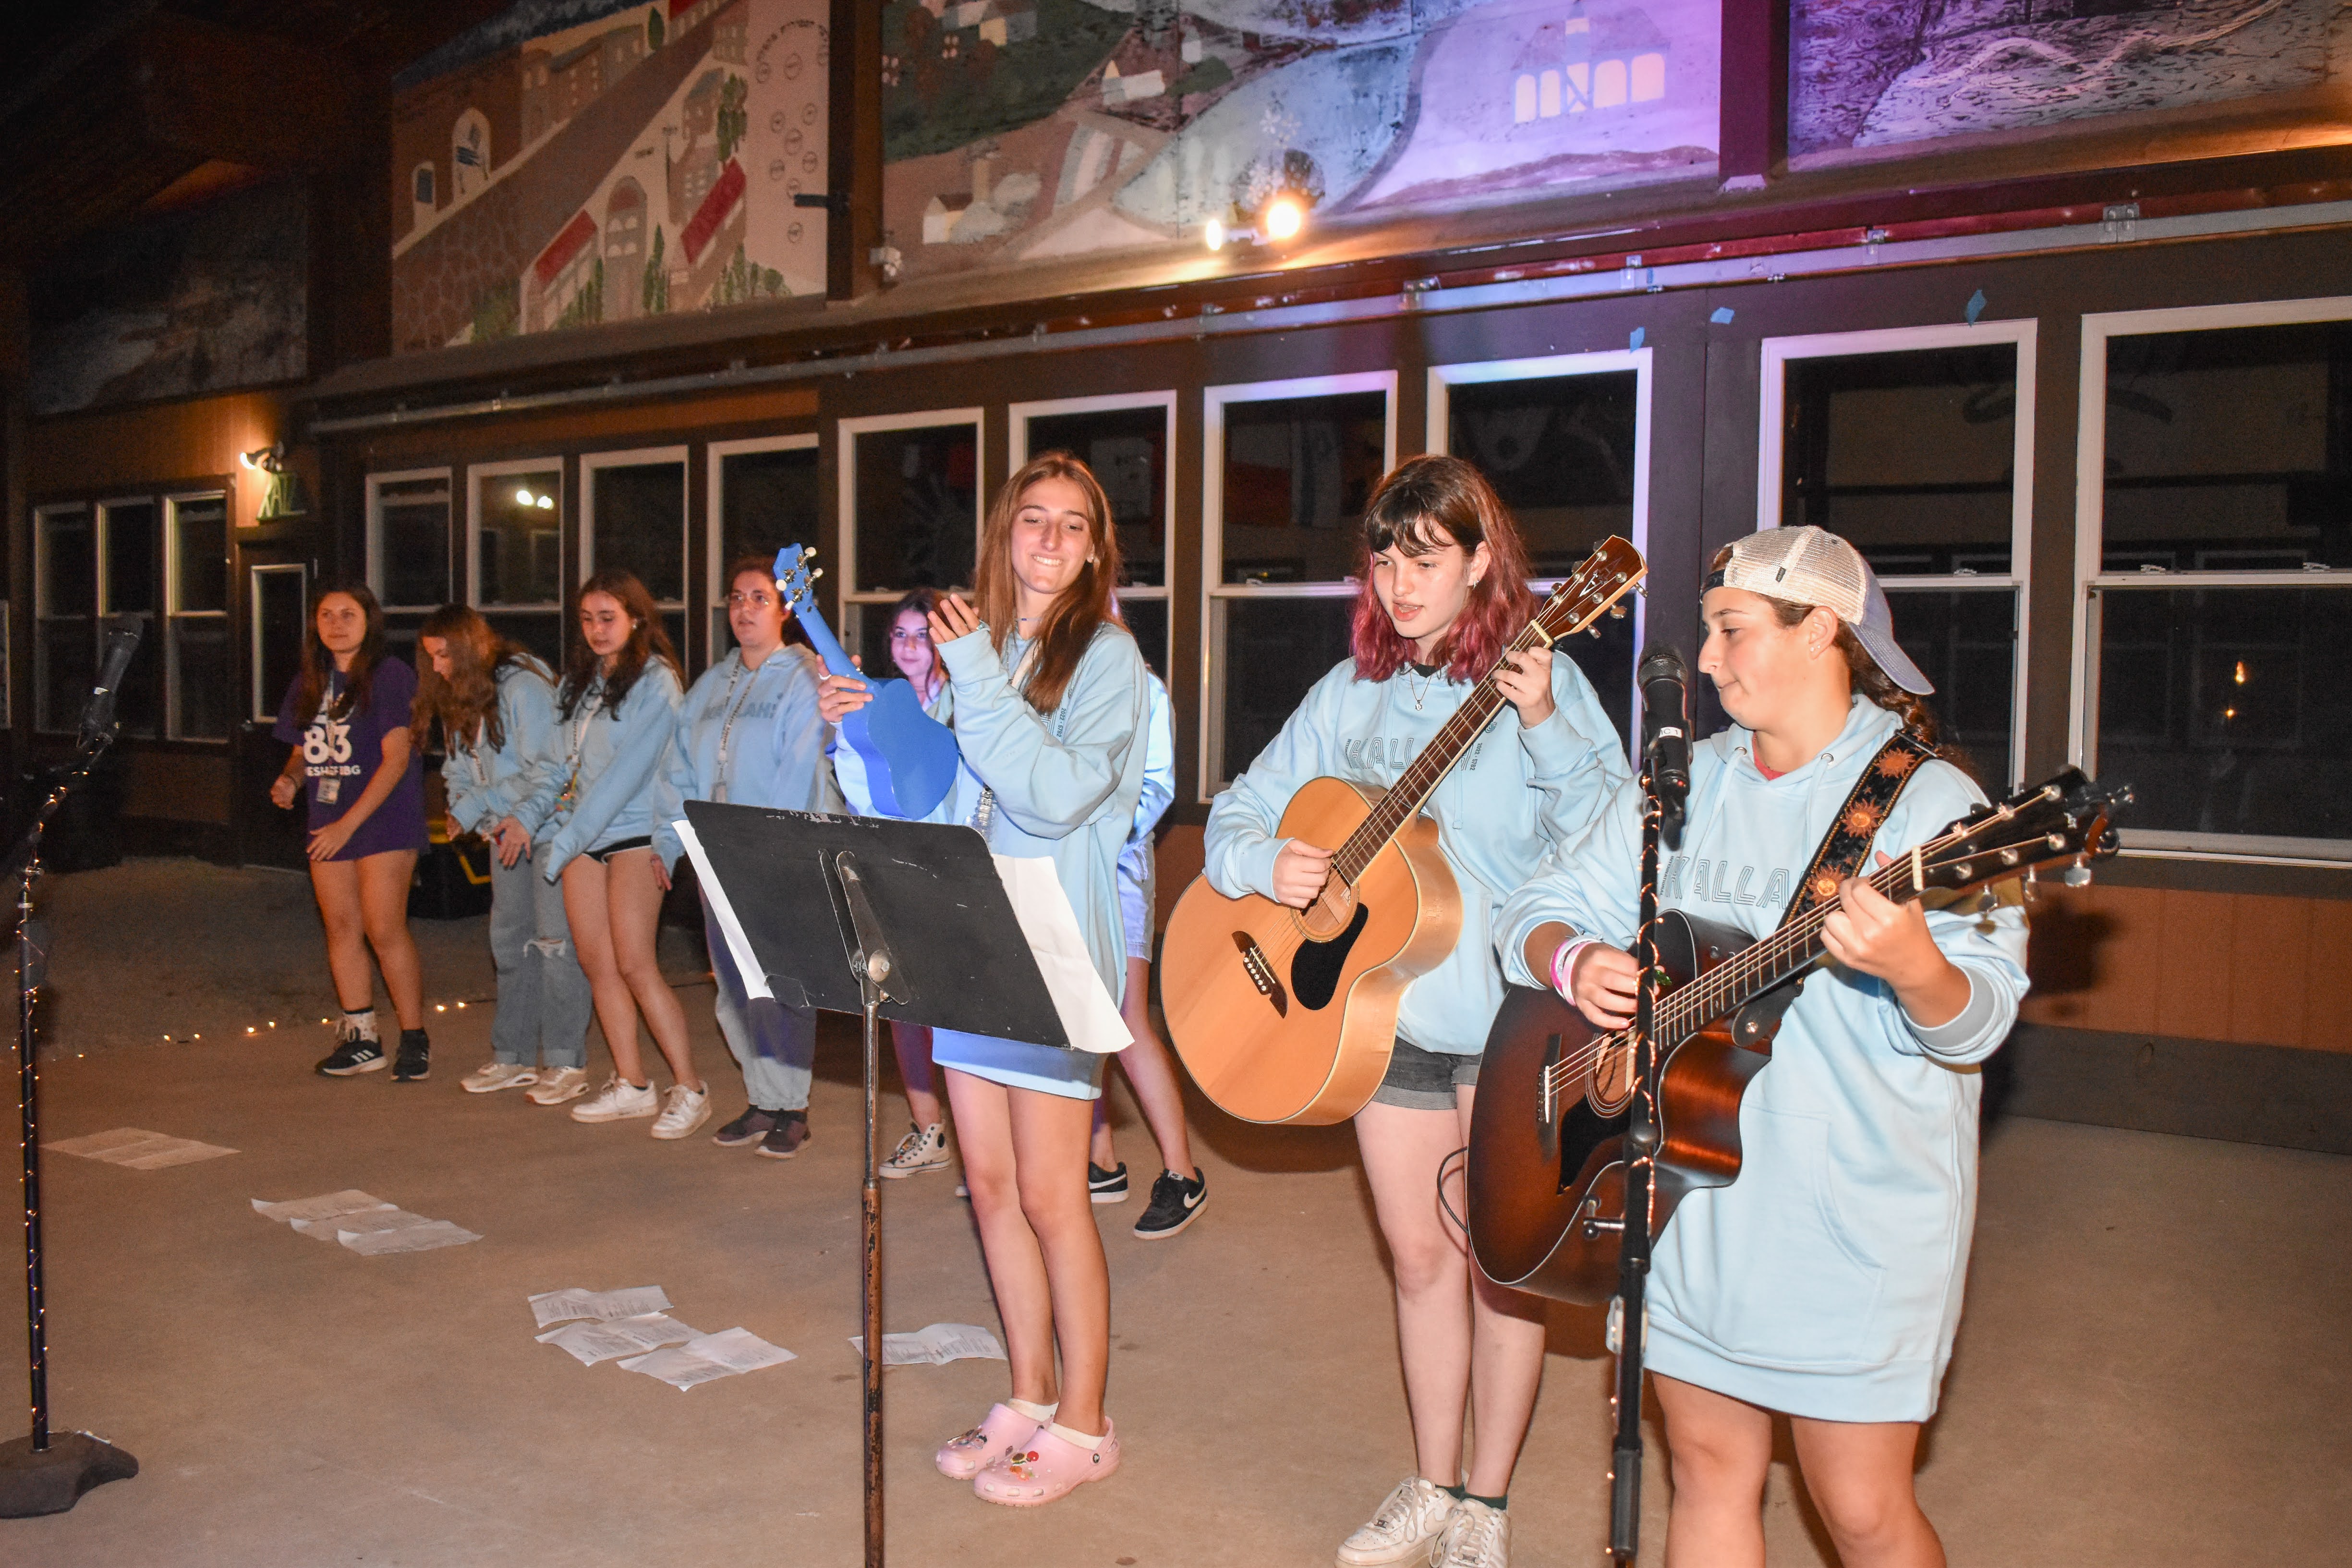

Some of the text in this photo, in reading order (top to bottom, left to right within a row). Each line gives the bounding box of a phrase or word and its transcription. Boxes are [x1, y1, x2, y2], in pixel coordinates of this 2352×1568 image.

[303, 724, 352, 764] 83
[1349, 737, 1474, 771] KALL
[1469, 742, 1483, 771] 2022 5782
[1665, 856, 1804, 910] KALLA
